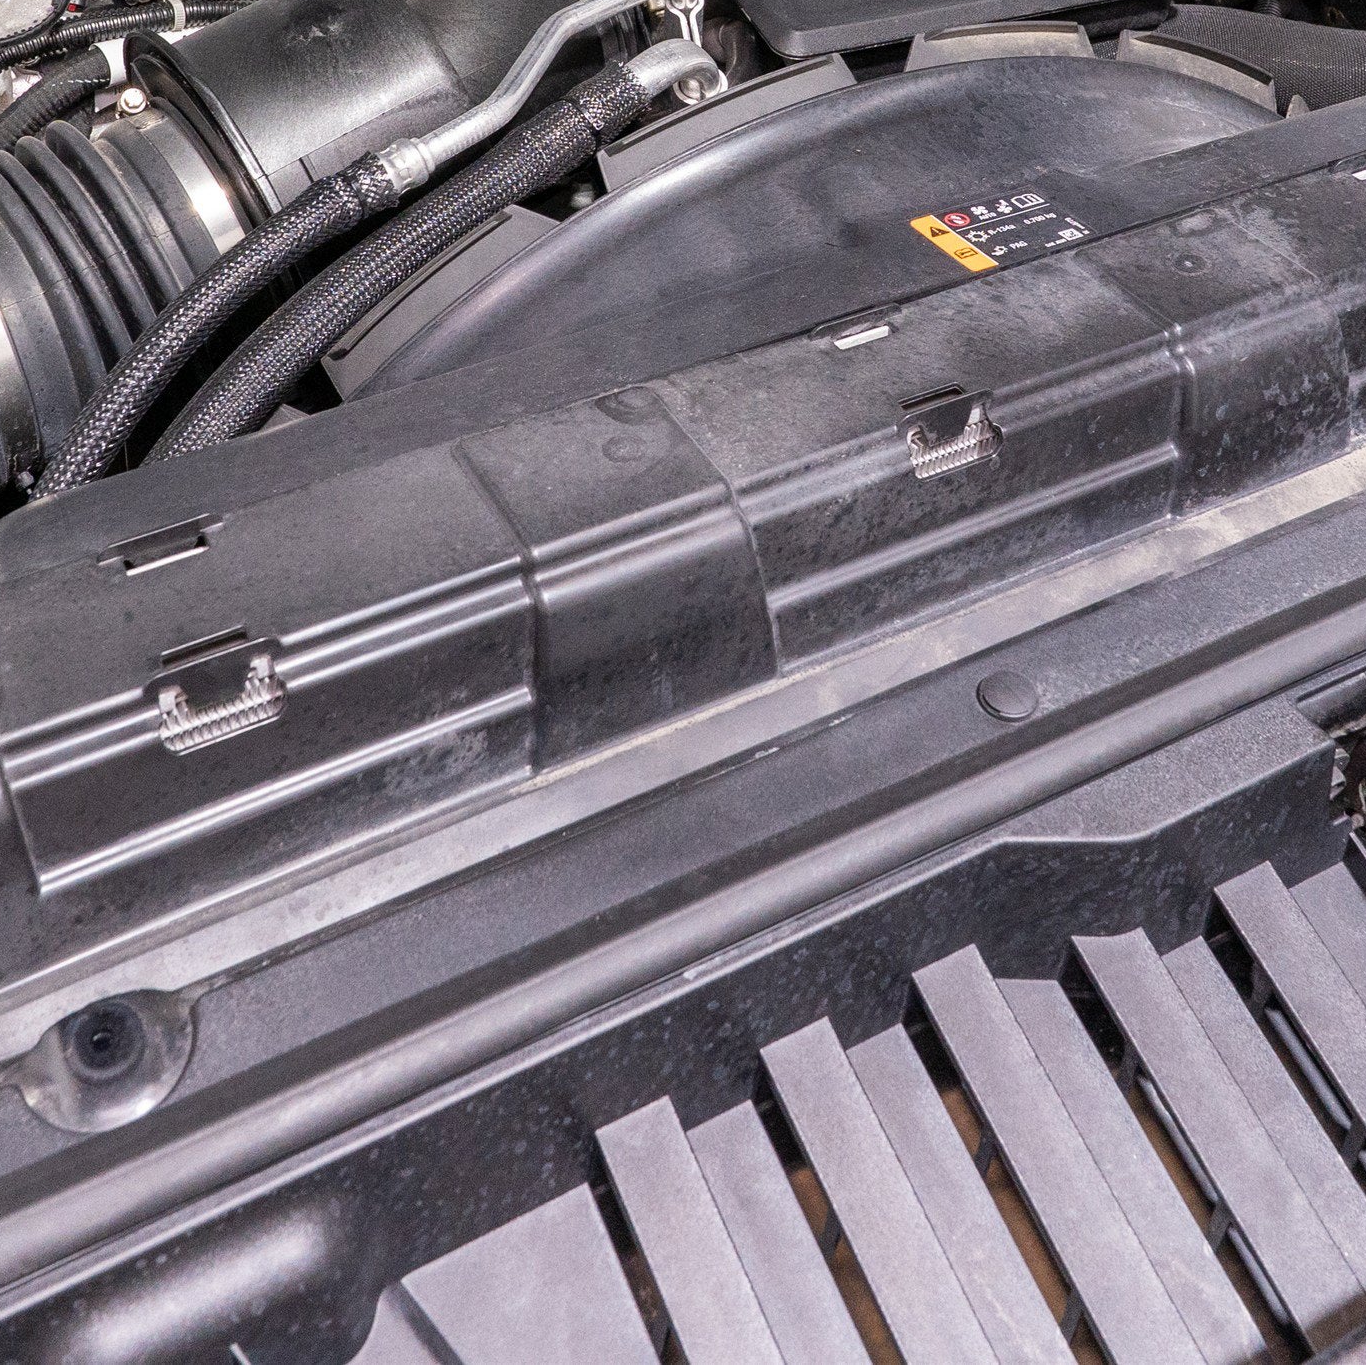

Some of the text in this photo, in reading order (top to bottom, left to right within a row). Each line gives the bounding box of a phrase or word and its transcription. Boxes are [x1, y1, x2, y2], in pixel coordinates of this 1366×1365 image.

[979, 212, 997, 220] AUTO
[987, 224, 1017, 236] R-134a
[1044, 212, 1057, 220] kg
[1009, 241, 1028, 250] PAG
